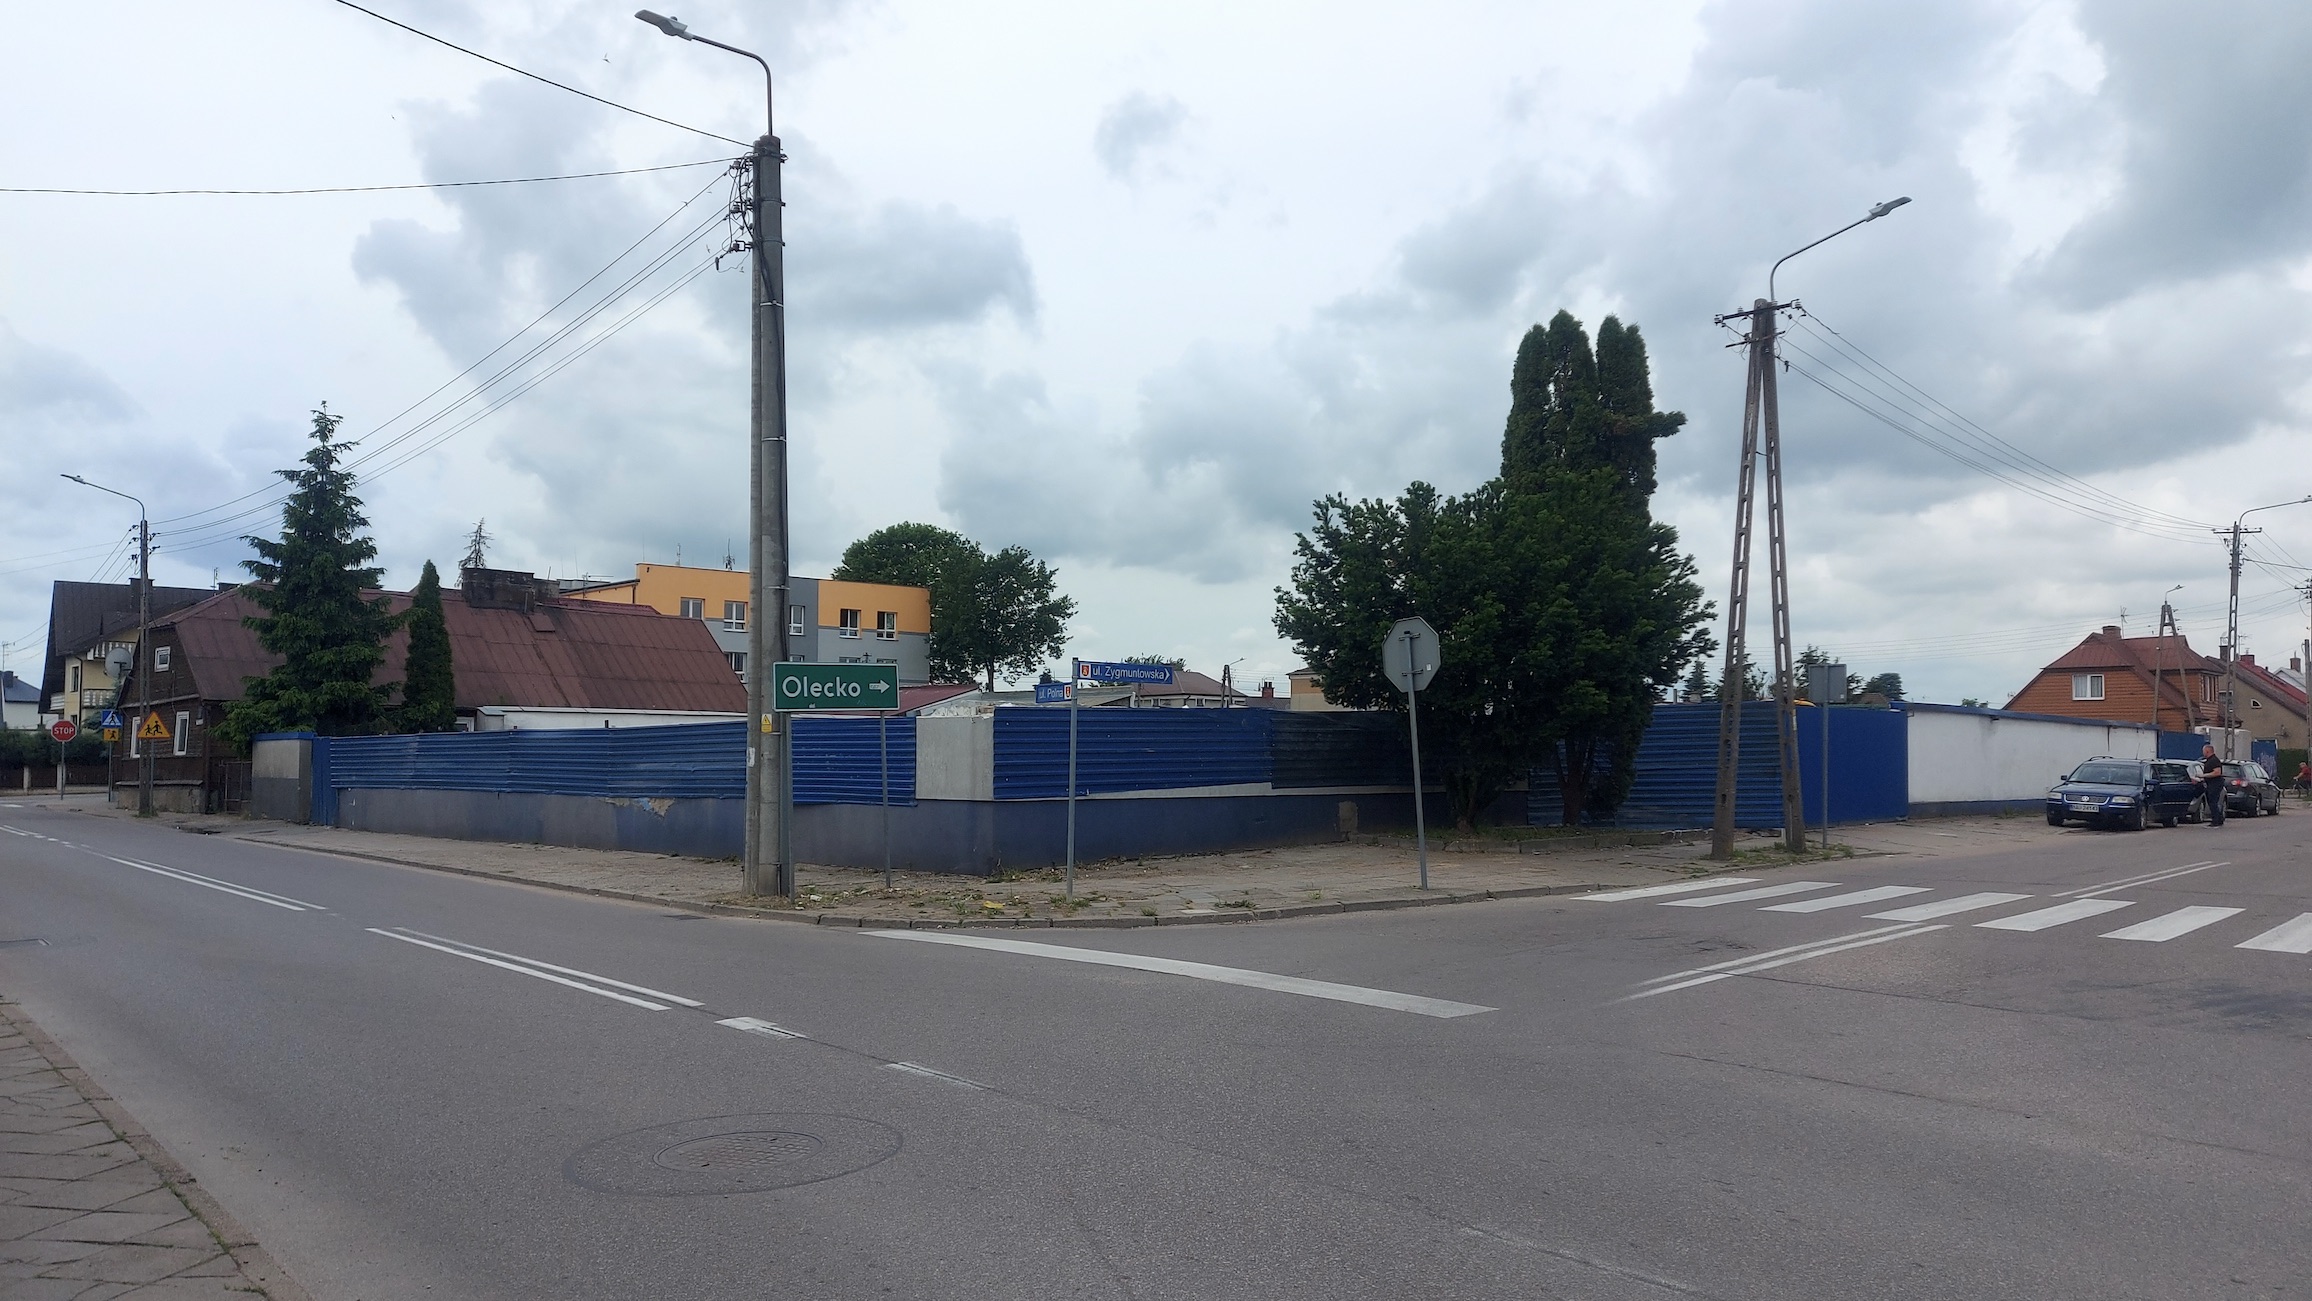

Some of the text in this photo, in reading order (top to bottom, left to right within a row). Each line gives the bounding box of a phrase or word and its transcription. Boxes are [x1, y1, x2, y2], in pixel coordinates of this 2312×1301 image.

[1093, 666, 1165, 681] ul. Zygmuntowska
[782, 676, 861, 698] Olecko
[1047, 688, 1063, 698] Polna
[54, 727, 75, 735] STOP
